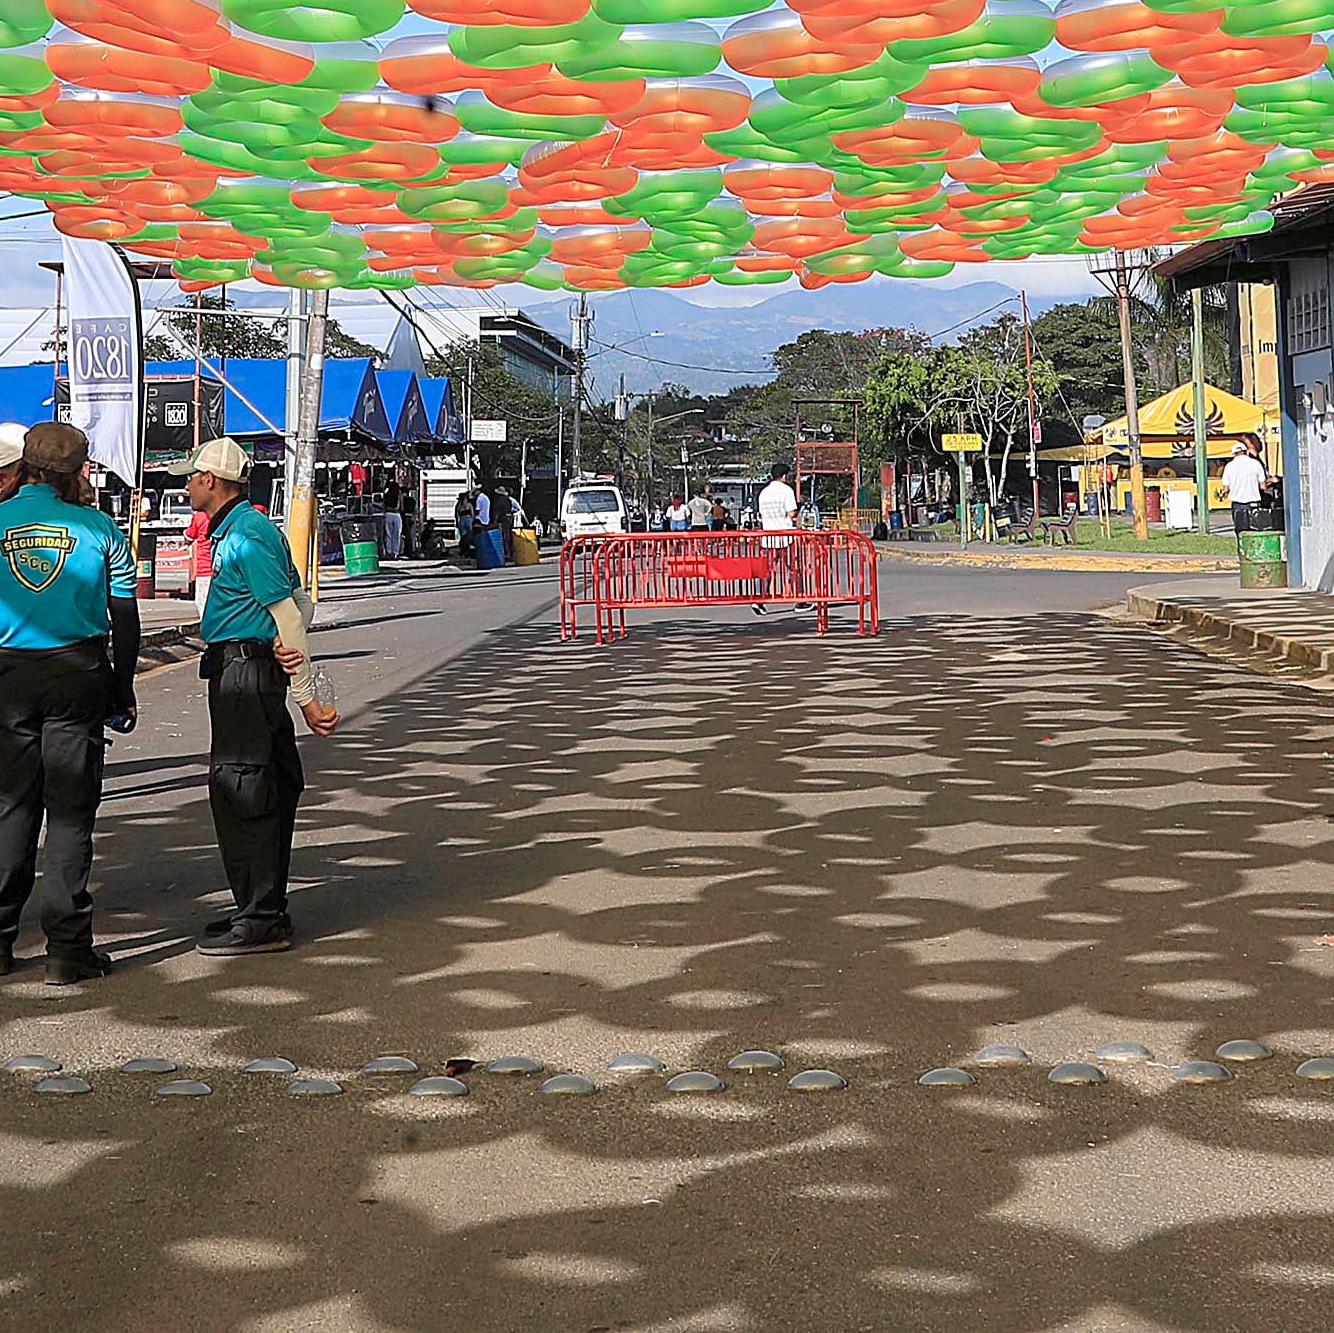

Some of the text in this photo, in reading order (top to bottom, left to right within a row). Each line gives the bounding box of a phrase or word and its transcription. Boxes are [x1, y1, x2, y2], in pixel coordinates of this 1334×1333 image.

[1259, 339, 1278, 356] Im
[167, 409, 185, 424] 1820
[946, 435, 977, 443] 25 KPH
[3, 537, 70, 551] SEGURIDAD
[19, 552, 50, 573] SCC
